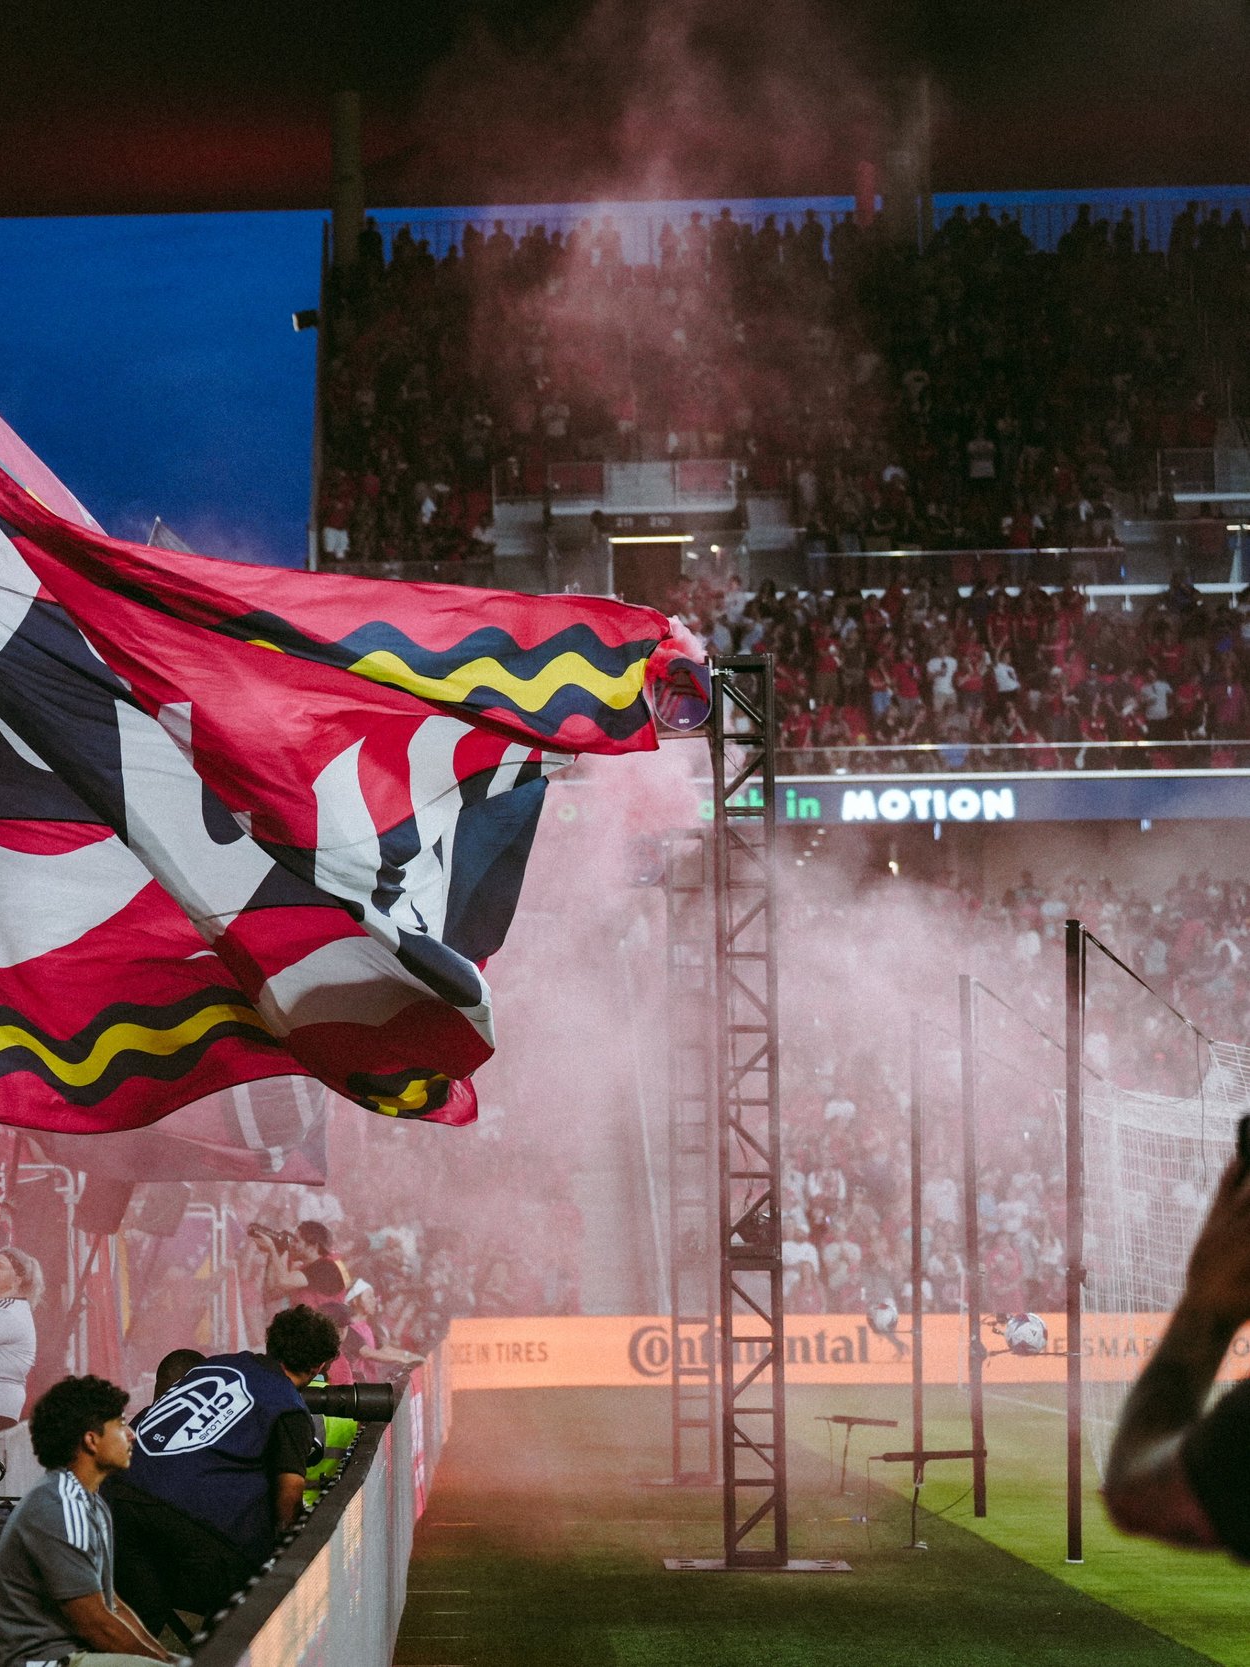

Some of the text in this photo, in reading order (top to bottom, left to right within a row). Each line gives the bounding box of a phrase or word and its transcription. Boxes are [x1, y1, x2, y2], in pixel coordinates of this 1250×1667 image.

[786, 788, 821, 820] in
[842, 788, 1015, 821] MOTION
[495, 1341, 549, 1363] TIRES
[183, 1391, 235, 1441] CITY
